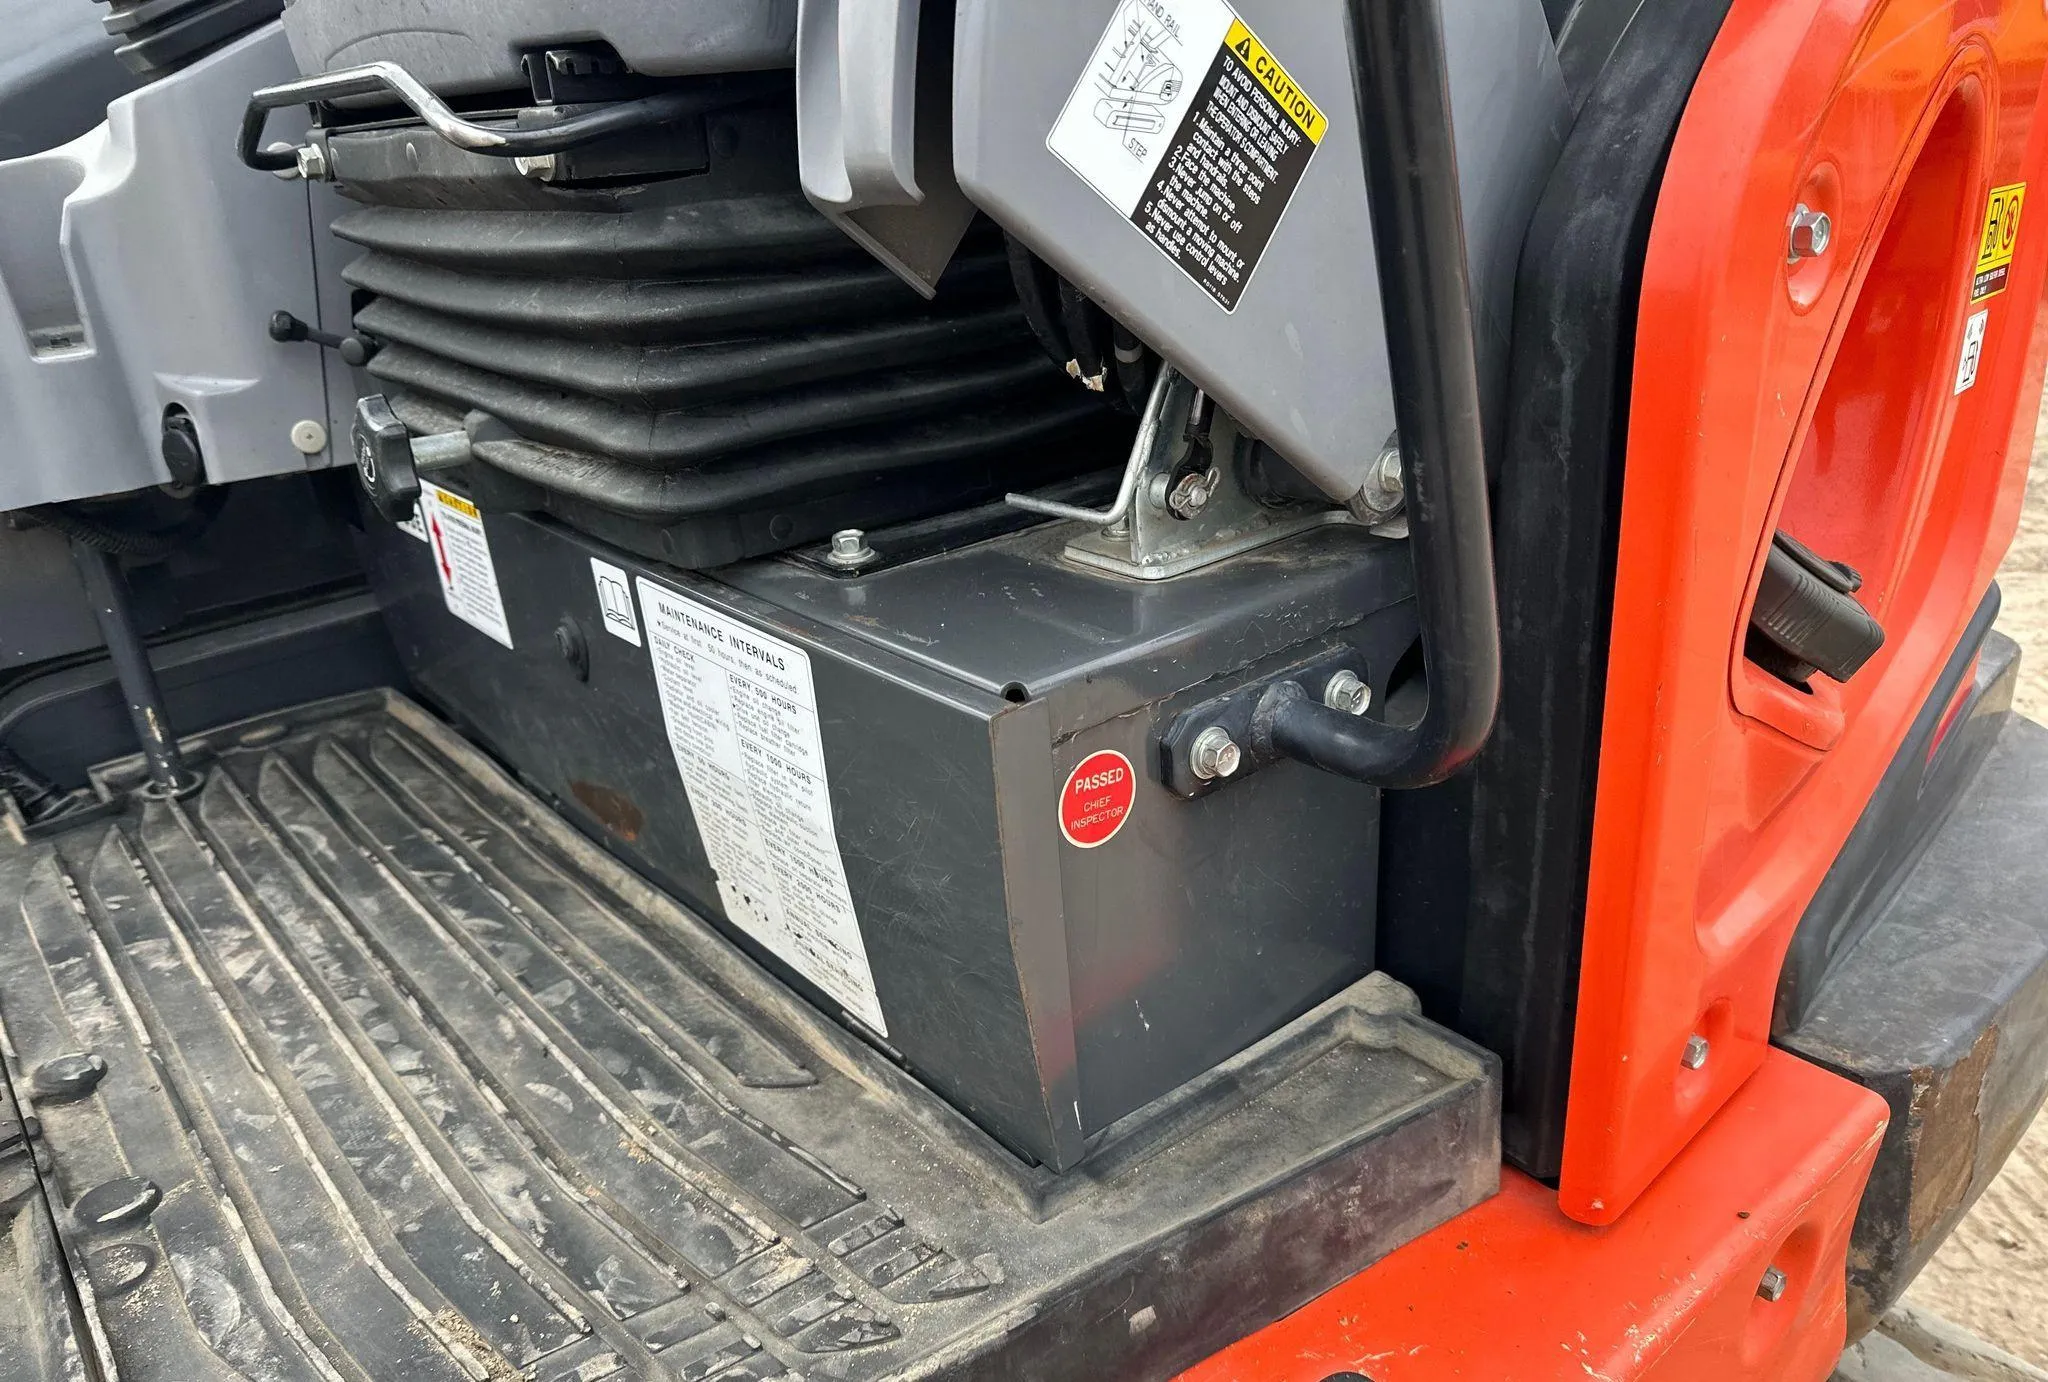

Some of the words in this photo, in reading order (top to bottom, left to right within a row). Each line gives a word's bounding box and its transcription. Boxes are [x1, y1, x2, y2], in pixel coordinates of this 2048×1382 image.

[1144, 0, 1164, 18] AND
[1164, 14, 1181, 38] RAIL
[1205, 100, 1219, 118] THE
[1219, 75, 1237, 99] MOUNT
[1236, 94, 1248, 110] AND
[1246, 106, 1270, 135] DISMOUNT
[1268, 130, 1288, 155] SAFELY
[1222, 55, 1234, 72] TO
[1232, 67, 1252, 92] AVOID
[1250, 87, 1280, 123] PERSONAL
[1278, 118, 1302, 148] INJURY:
[1256, 56, 1315, 129] CAUTION
[1213, 87, 1229, 107] WHEN
[1227, 102, 1251, 132] ENTERING
[1249, 127, 1259, 141] OR
[1256, 135, 1277, 161] LEAVING
[1128, 137, 1149, 159] STEP
[1186, 141, 1201, 159] and
[1199, 154, 1229, 189] handrails.
[1192, 130, 1218, 160] contact
[1217, 155, 1232, 175] with
[1231, 169, 1244, 187] the
[1242, 183, 1260, 205] steps
[1224, 147, 1230, 157] a
[1169, 174, 1182, 192] the
[1181, 187, 1209, 219] machine.
[1195, 183, 1213, 206] jump
[1212, 202, 1222, 215] on
[1221, 211, 1230, 223] or
[1229, 217, 1242, 234] off
[1197, 169, 1210, 186] the
[1210, 181, 1237, 213] machine.
[1145, 219, 1156, 234] as
[1154, 228, 1182, 260] handles.
[1157, 196, 1186, 230] dismount
[1185, 226, 1192, 236] a
[1191, 231, 1215, 259] moving
[1214, 253, 1240, 283] machine.
[1172, 230, 1185, 246] use
[1185, 241, 1207, 267] control
[1207, 262, 1227, 286] levers
[1183, 206, 1209, 236] attempt
[1208, 230, 1217, 243] to
[1217, 239, 1236, 262] mount
[1235, 259, 1244, 270] or
[658, 602, 723, 642] MAINTENANCE
[728, 634, 785, 671] INTERVALS
[673, 645, 694, 662] CHECK
[729, 673, 750, 691] EVERY
[771, 695, 796, 714] HOURS
[754, 667, 762, 677] as
[740, 738, 761, 756] EVERY
[766, 753, 781, 767] 1000
[786, 764, 810, 784] HOURS
[1074, 767, 1124, 795] PASSED
[1070, 806, 1124, 831] INSPECTOR
[1083, 795, 1112, 813] CHIEF
[765, 838, 785, 856] EVERY
[772, 862, 792, 881] EVERY
[816, 891, 840, 914] HOURS
